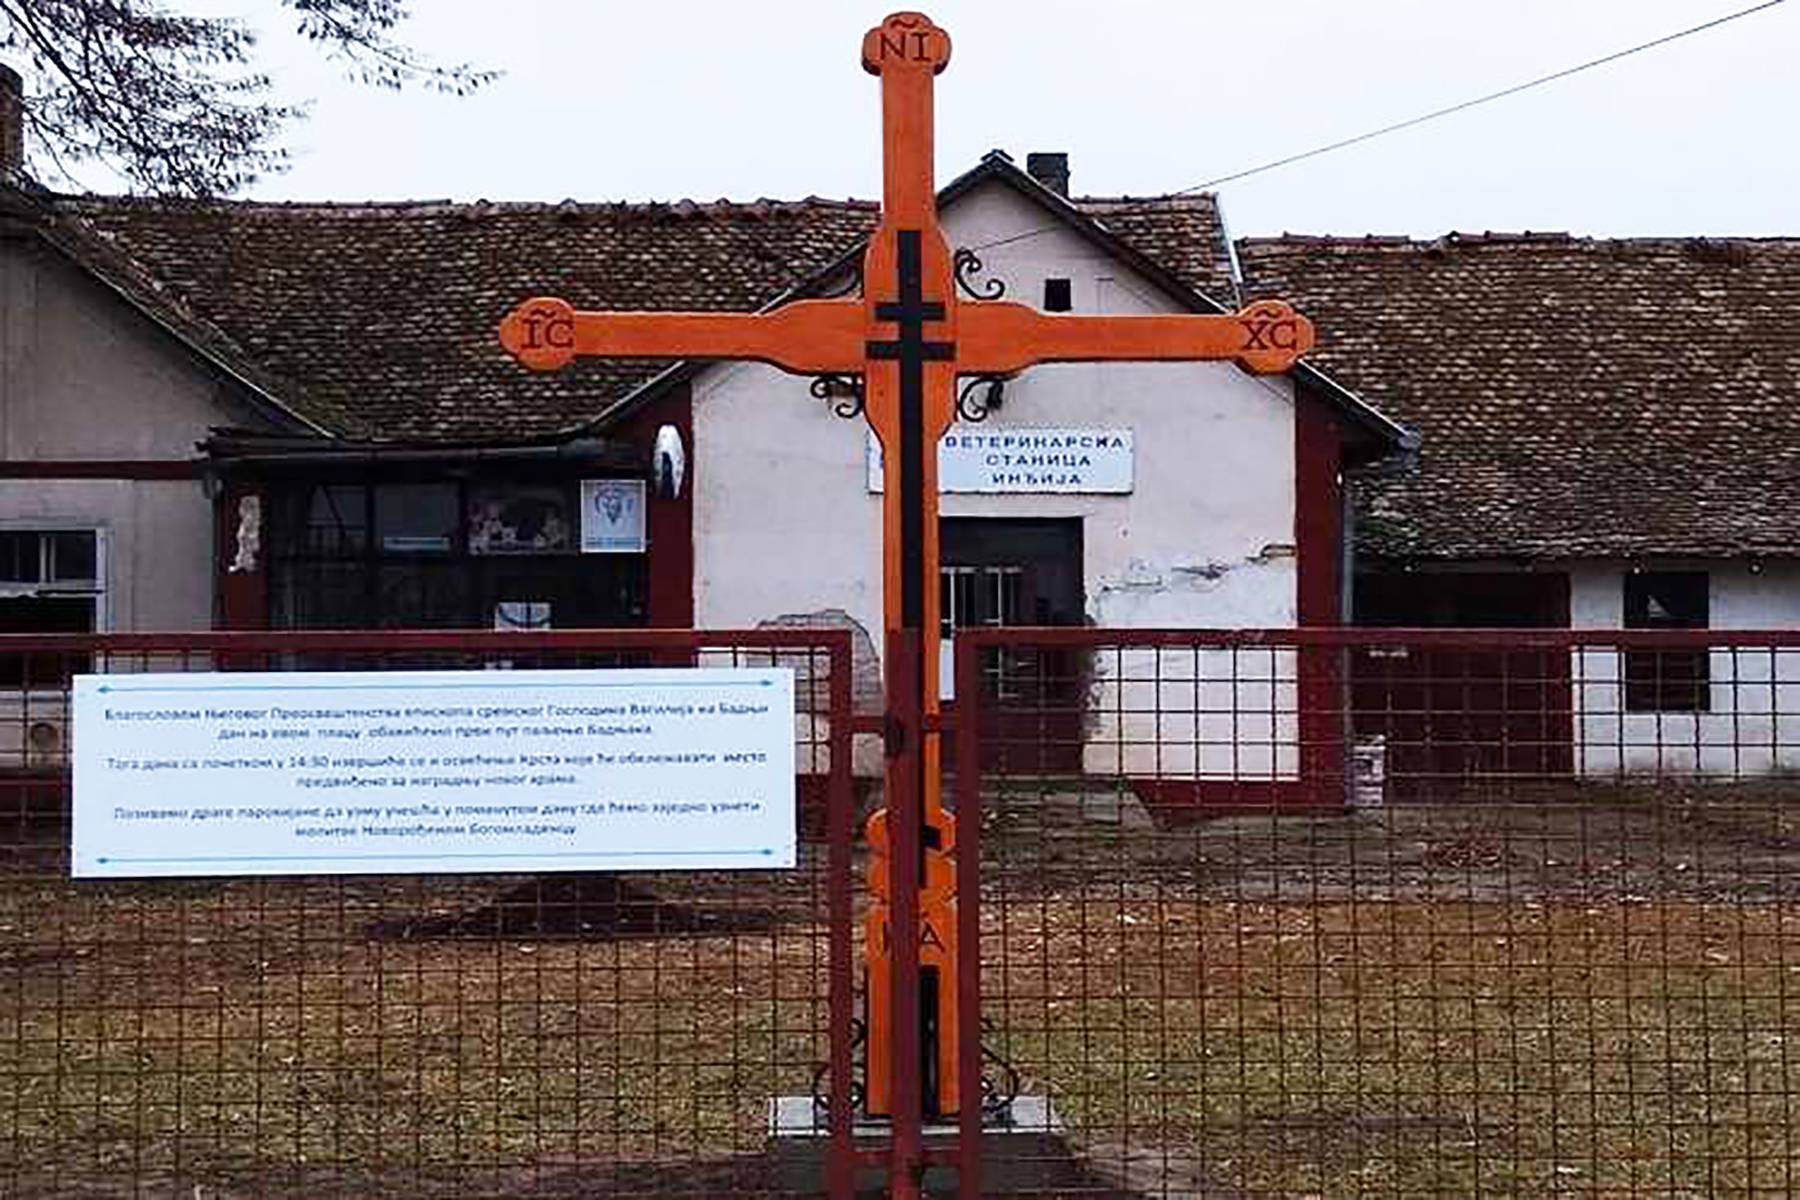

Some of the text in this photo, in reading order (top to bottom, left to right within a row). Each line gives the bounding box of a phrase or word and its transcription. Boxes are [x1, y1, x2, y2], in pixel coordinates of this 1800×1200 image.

[944, 436, 1125, 449] ВЕТЕРИНАРСКА
[985, 454, 1091, 467] СТАНИЦА
[992, 473, 1081, 485] ИНЂИЈА
[697, 704, 714, 713] на
[217, 730, 245, 741] дан
[496, 727, 518, 737] пут
